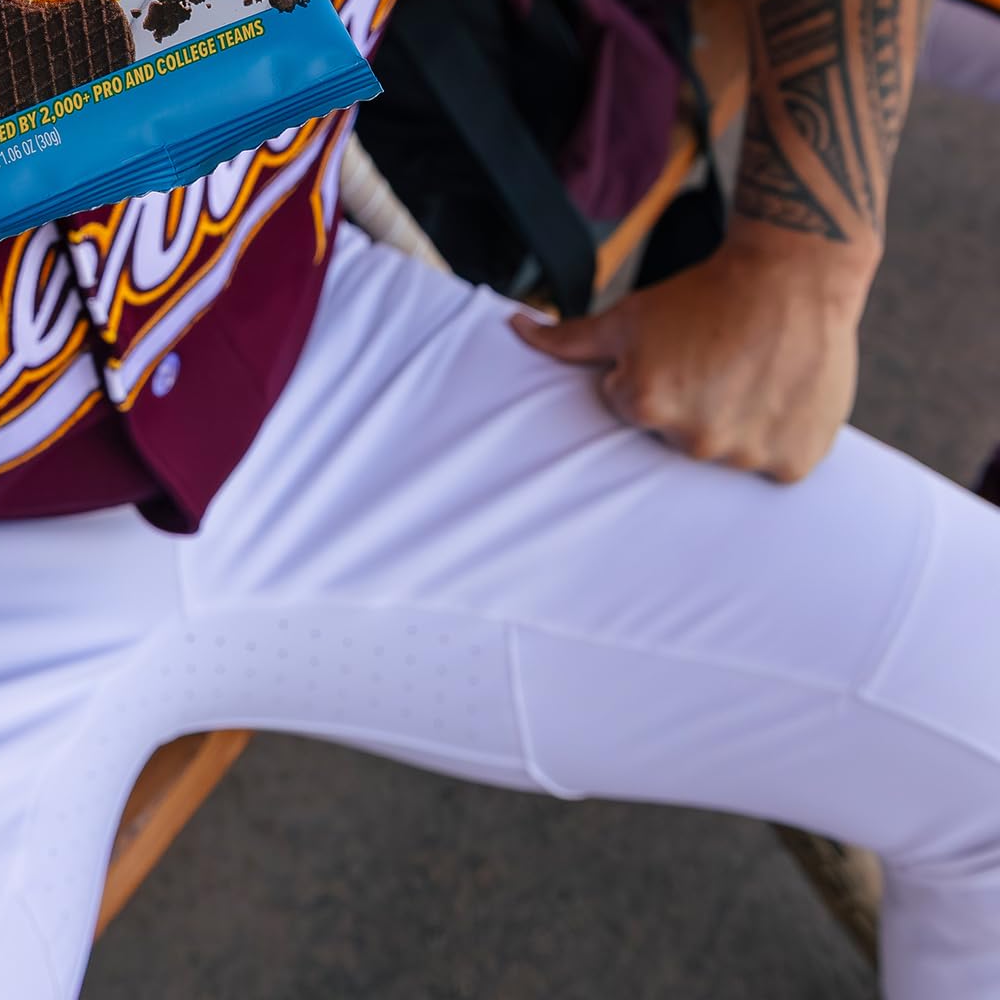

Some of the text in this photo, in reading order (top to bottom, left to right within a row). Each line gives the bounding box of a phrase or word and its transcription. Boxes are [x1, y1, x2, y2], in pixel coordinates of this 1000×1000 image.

[18, 112, 39, 134] BY
[40, 91, 91, 125] 2,000+
[93, 74, 123, 104] PRO
[125, 62, 155, 90] AND
[155, 37, 217, 76] COLLEGE
[217, 18, 265, 52] TEAMS
[0, 144, 22, 166] 1.06
[21, 139, 36, 156] OZ
[36, 127, 62, 153] (30g)
